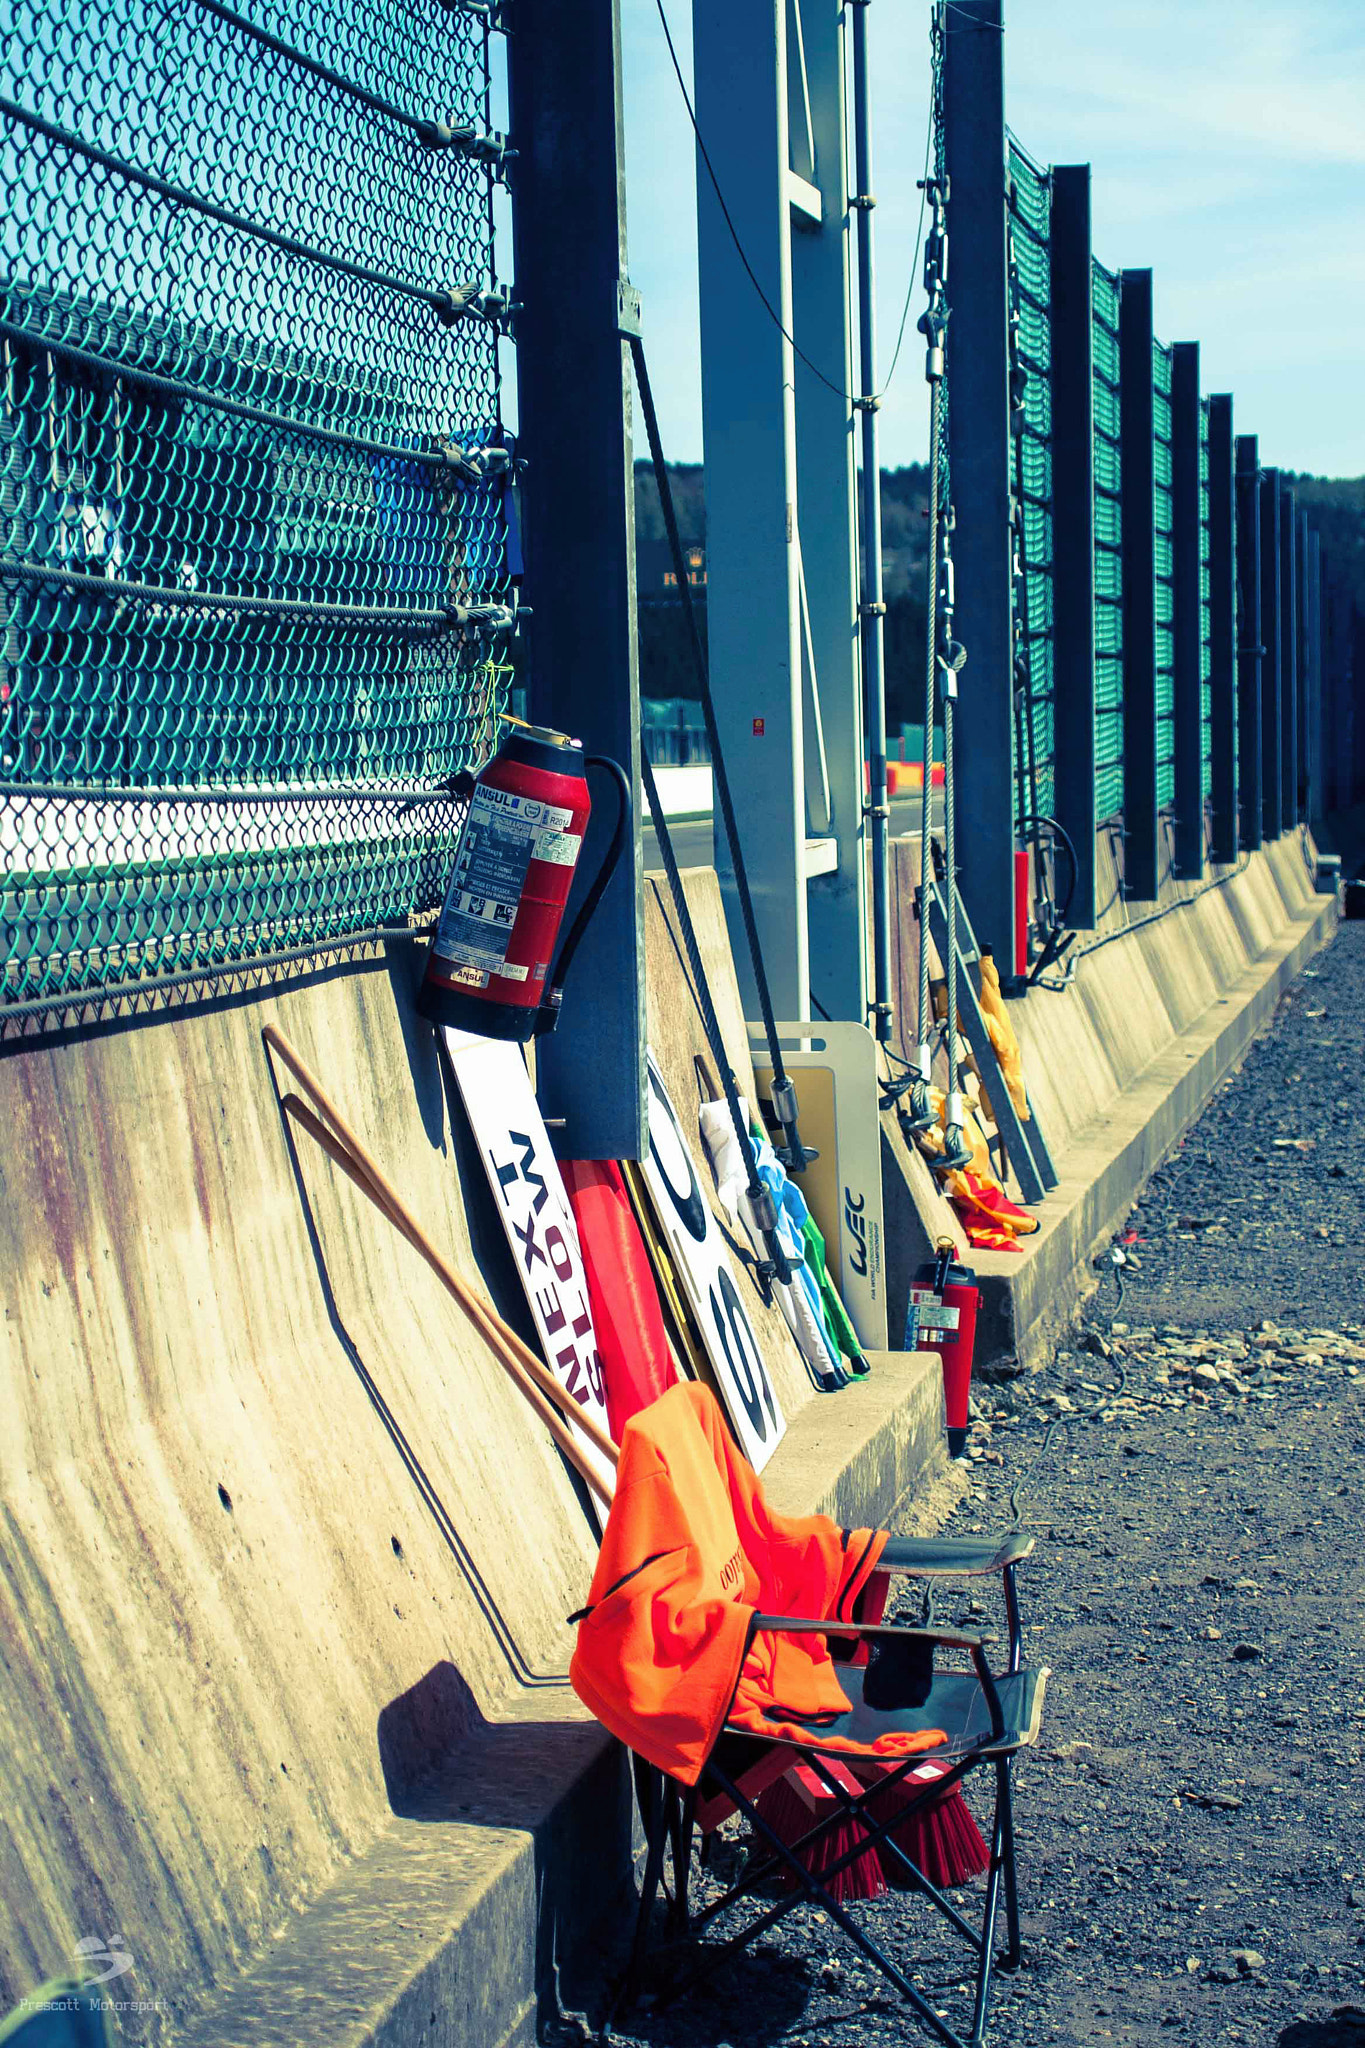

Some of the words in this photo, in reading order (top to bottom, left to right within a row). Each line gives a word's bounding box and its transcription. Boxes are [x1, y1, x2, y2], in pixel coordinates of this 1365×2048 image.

[475, 786, 511, 806] ANSUL
[457, 970, 486, 984] ANSUL
[508, 1130, 604, 1407] SLOW
[844, 1186, 868, 1277] WEC
[489, 1149, 590, 1406] NEXT
